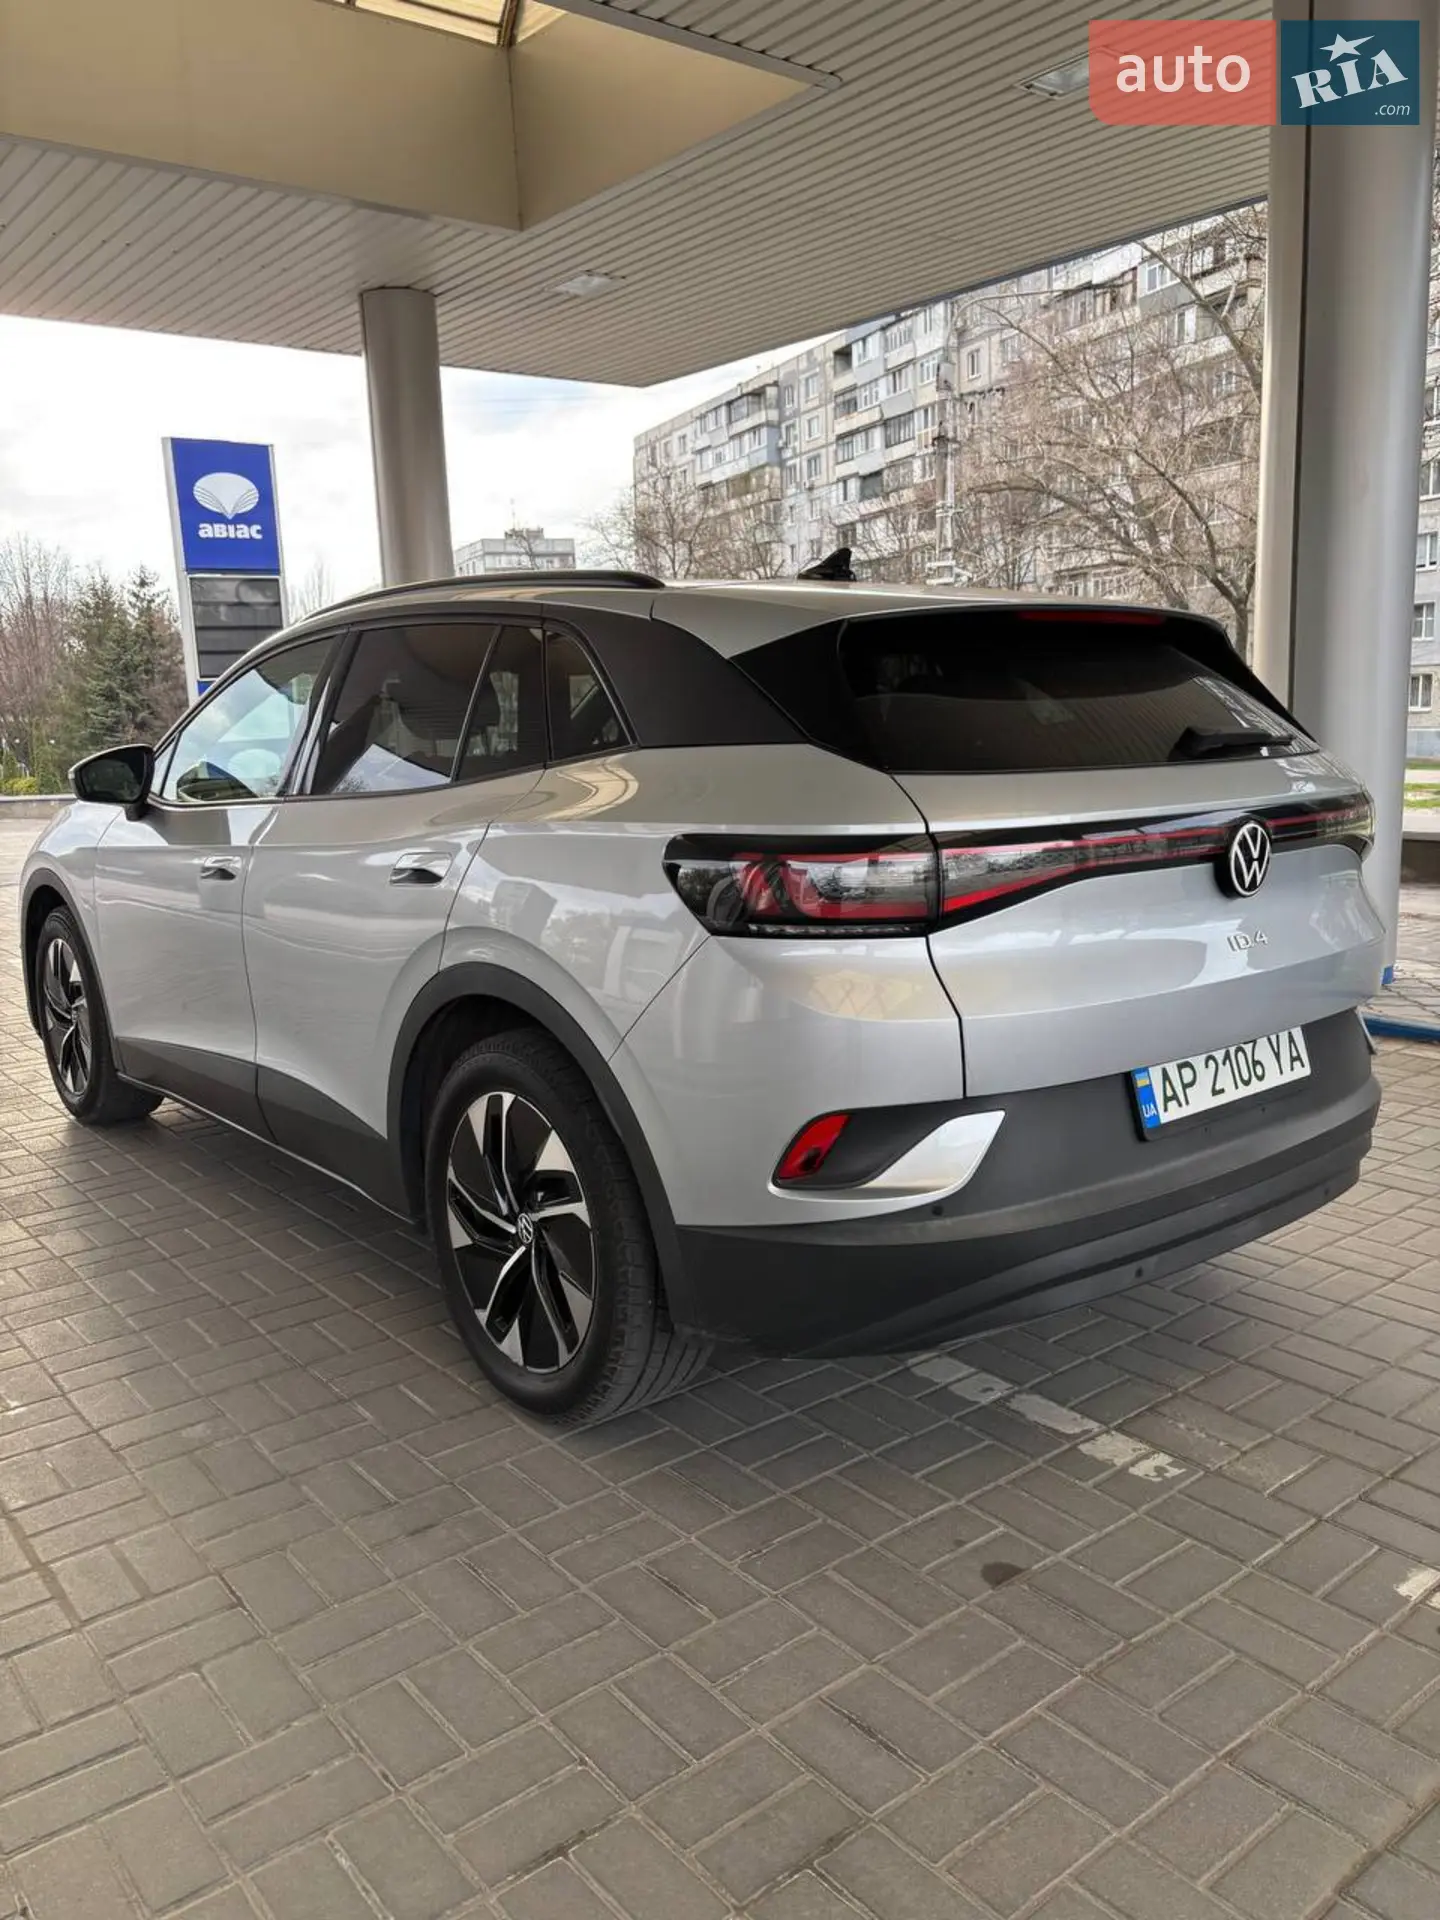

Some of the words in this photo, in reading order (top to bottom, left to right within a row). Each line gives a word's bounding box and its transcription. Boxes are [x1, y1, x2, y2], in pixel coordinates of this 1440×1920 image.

[1161, 1060, 1198, 1113] AP
[1204, 1040, 1266, 1097] 2106
[1267, 1031, 1305, 1076] YA
[1142, 1103, 1158, 1118] UA
